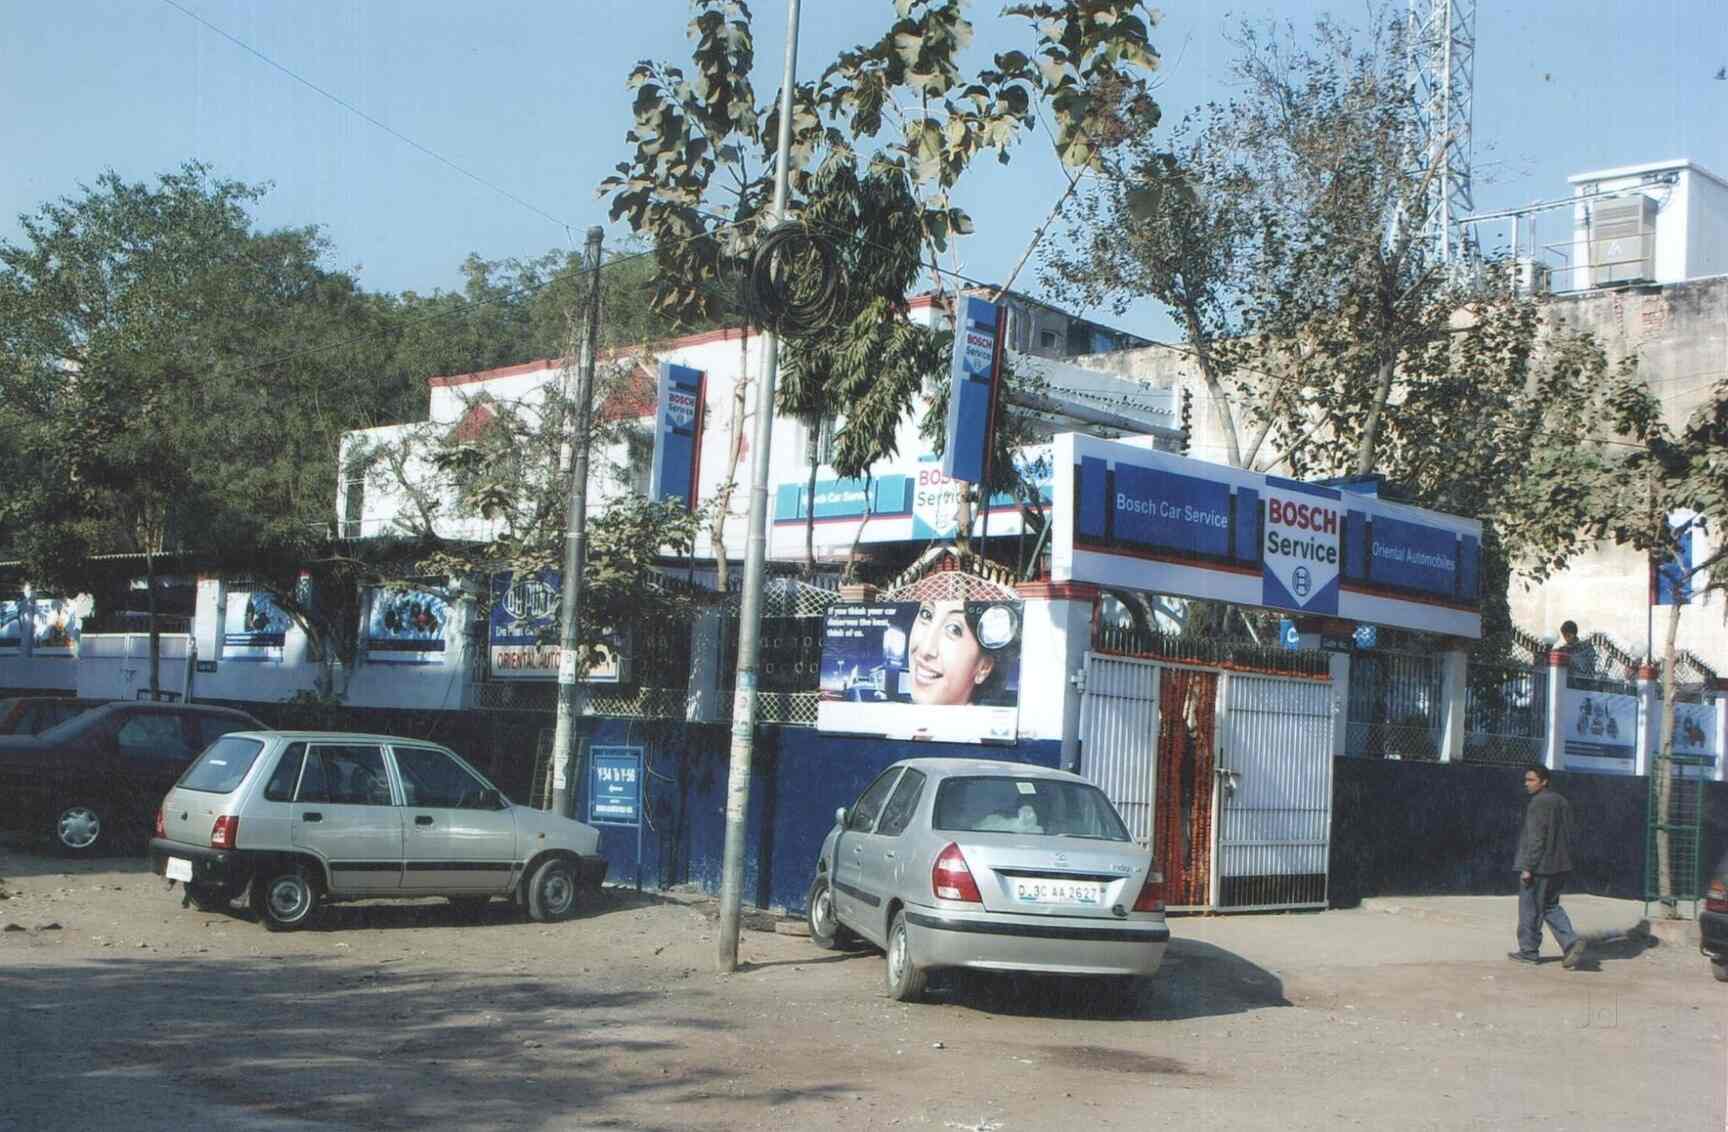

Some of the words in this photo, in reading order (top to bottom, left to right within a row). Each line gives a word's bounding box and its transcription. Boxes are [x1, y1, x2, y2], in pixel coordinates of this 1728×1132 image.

[967, 333, 993, 349] BOSCH
[1116, 493, 1157, 516] Bosch
[1160, 501, 1182, 520] Car
[1184, 505, 1229, 528] Service
[1269, 498, 1337, 535] BOSCH
[1267, 531, 1337, 564] Service
[1372, 542, 1406, 561] Oriental
[1407, 547, 1456, 571] Automobiles
[827, 606, 834, 615] If
[834, 608, 847, 617] you
[847, 606, 866, 615] think
[867, 608, 883, 617] your
[859, 618, 872, 626] the
[827, 629, 844, 637] think
[845, 629, 853, 637] of
